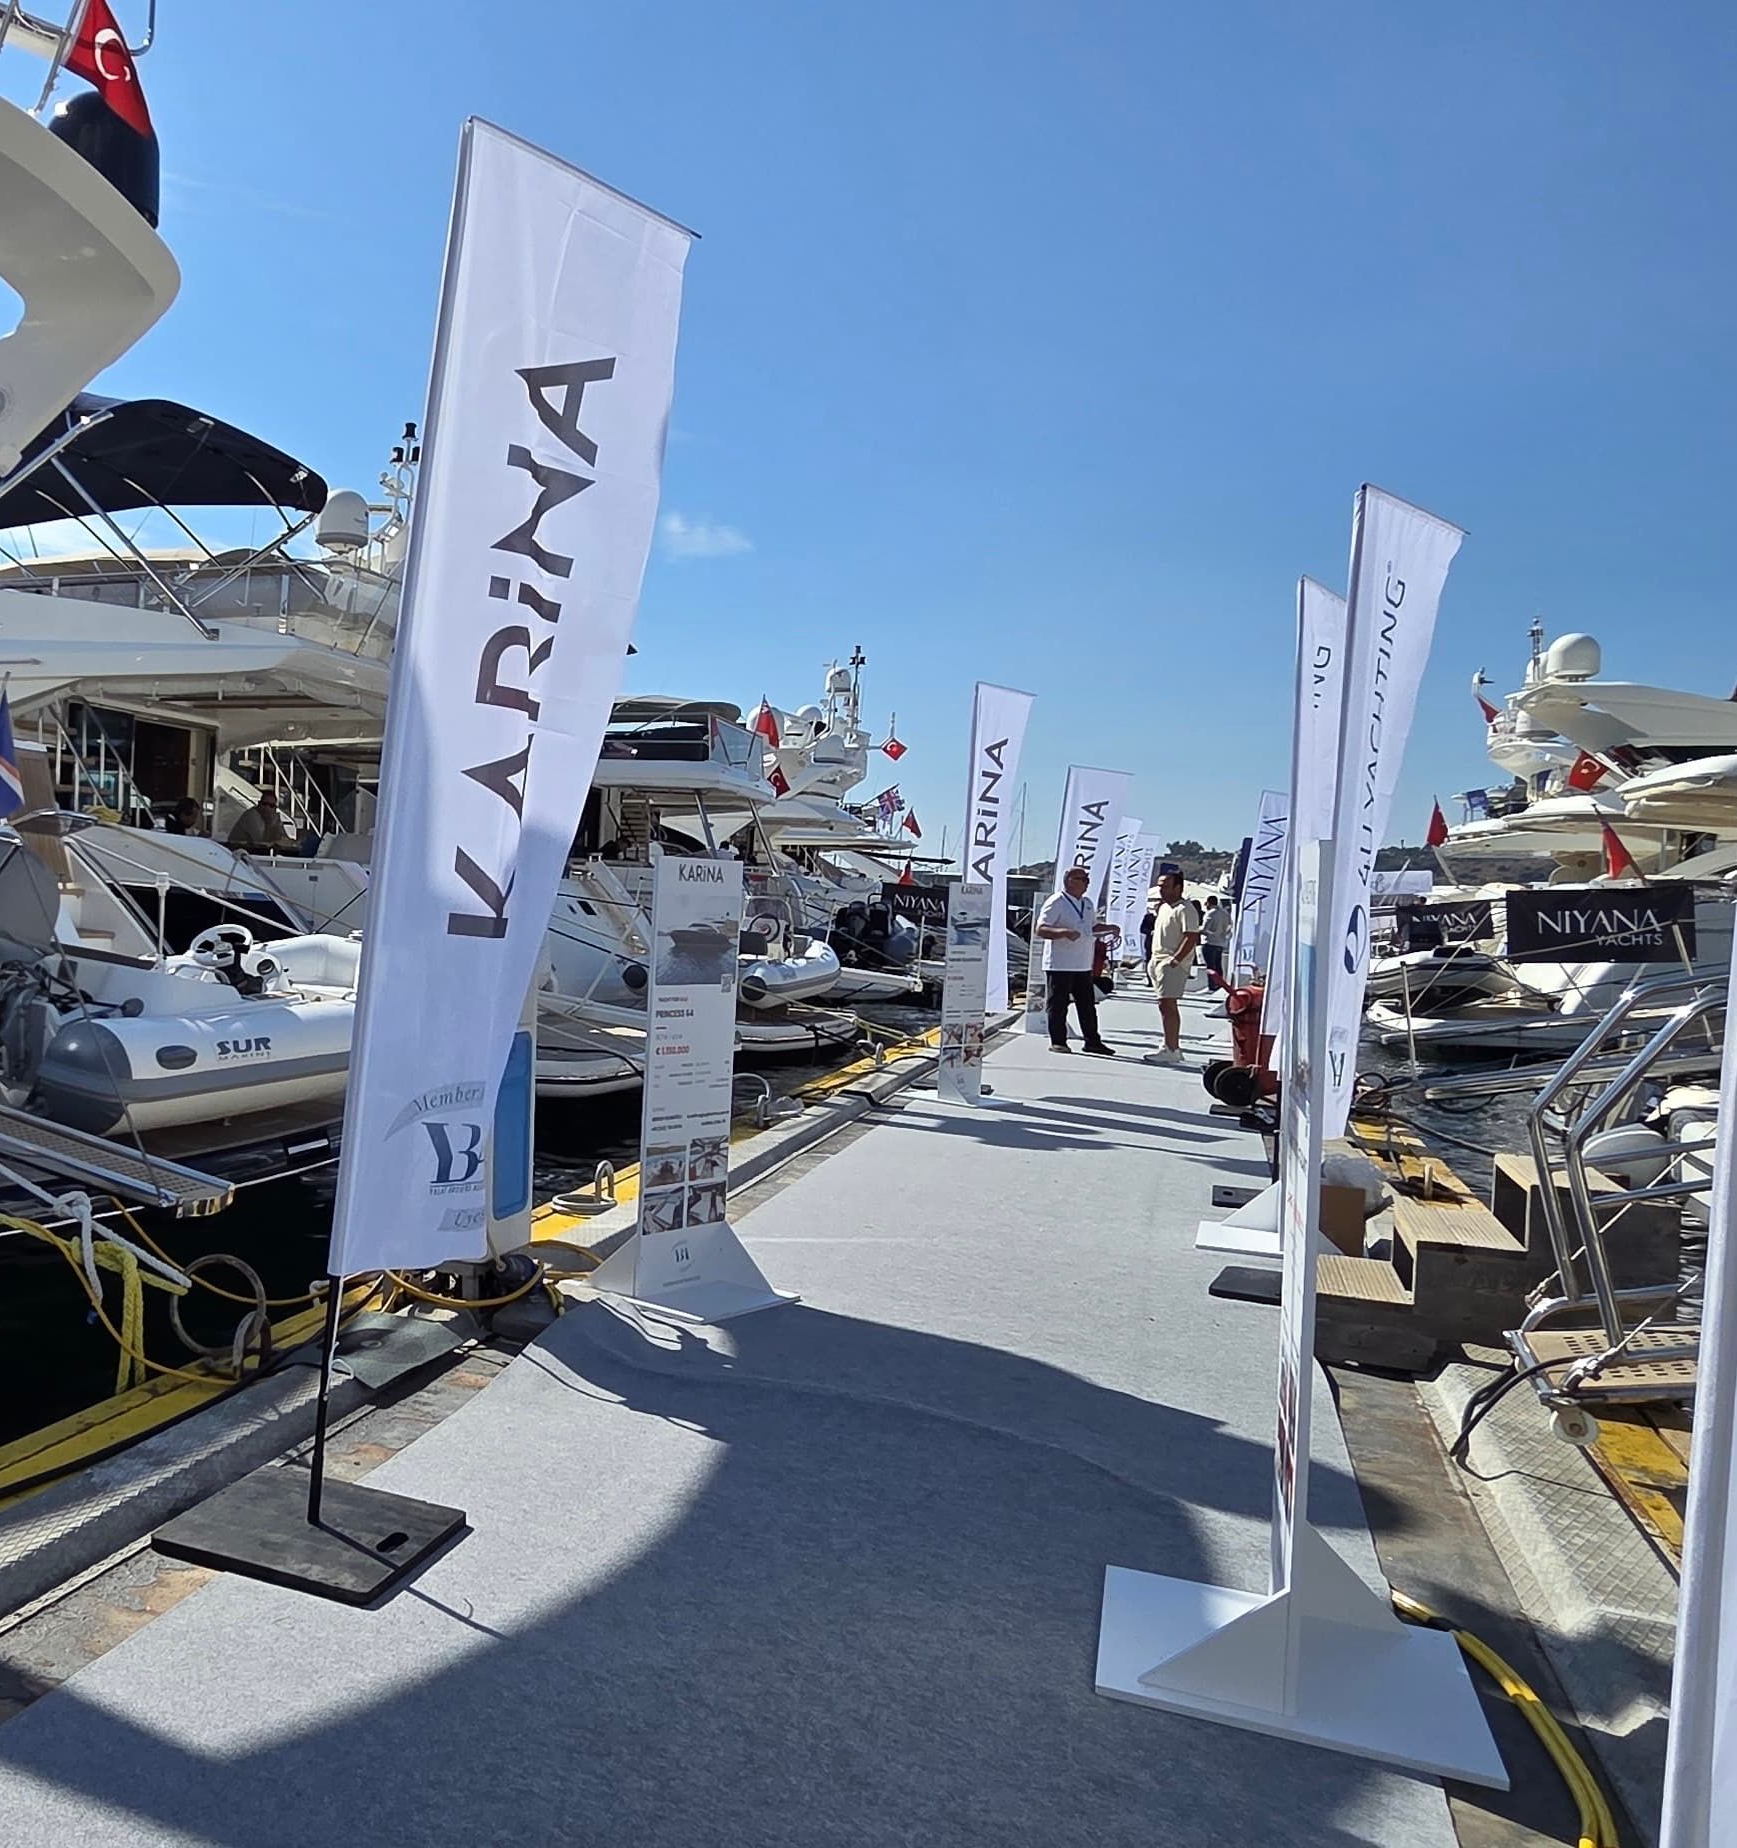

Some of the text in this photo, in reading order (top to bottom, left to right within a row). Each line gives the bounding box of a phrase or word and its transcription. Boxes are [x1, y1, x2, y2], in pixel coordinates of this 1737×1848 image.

[971, 737, 1009, 885] ARiNA
[1536, 907, 1663, 934] NIYANA
[1595, 932, 1663, 947] YACHTS
[216, 1036, 272, 1056] SUR
